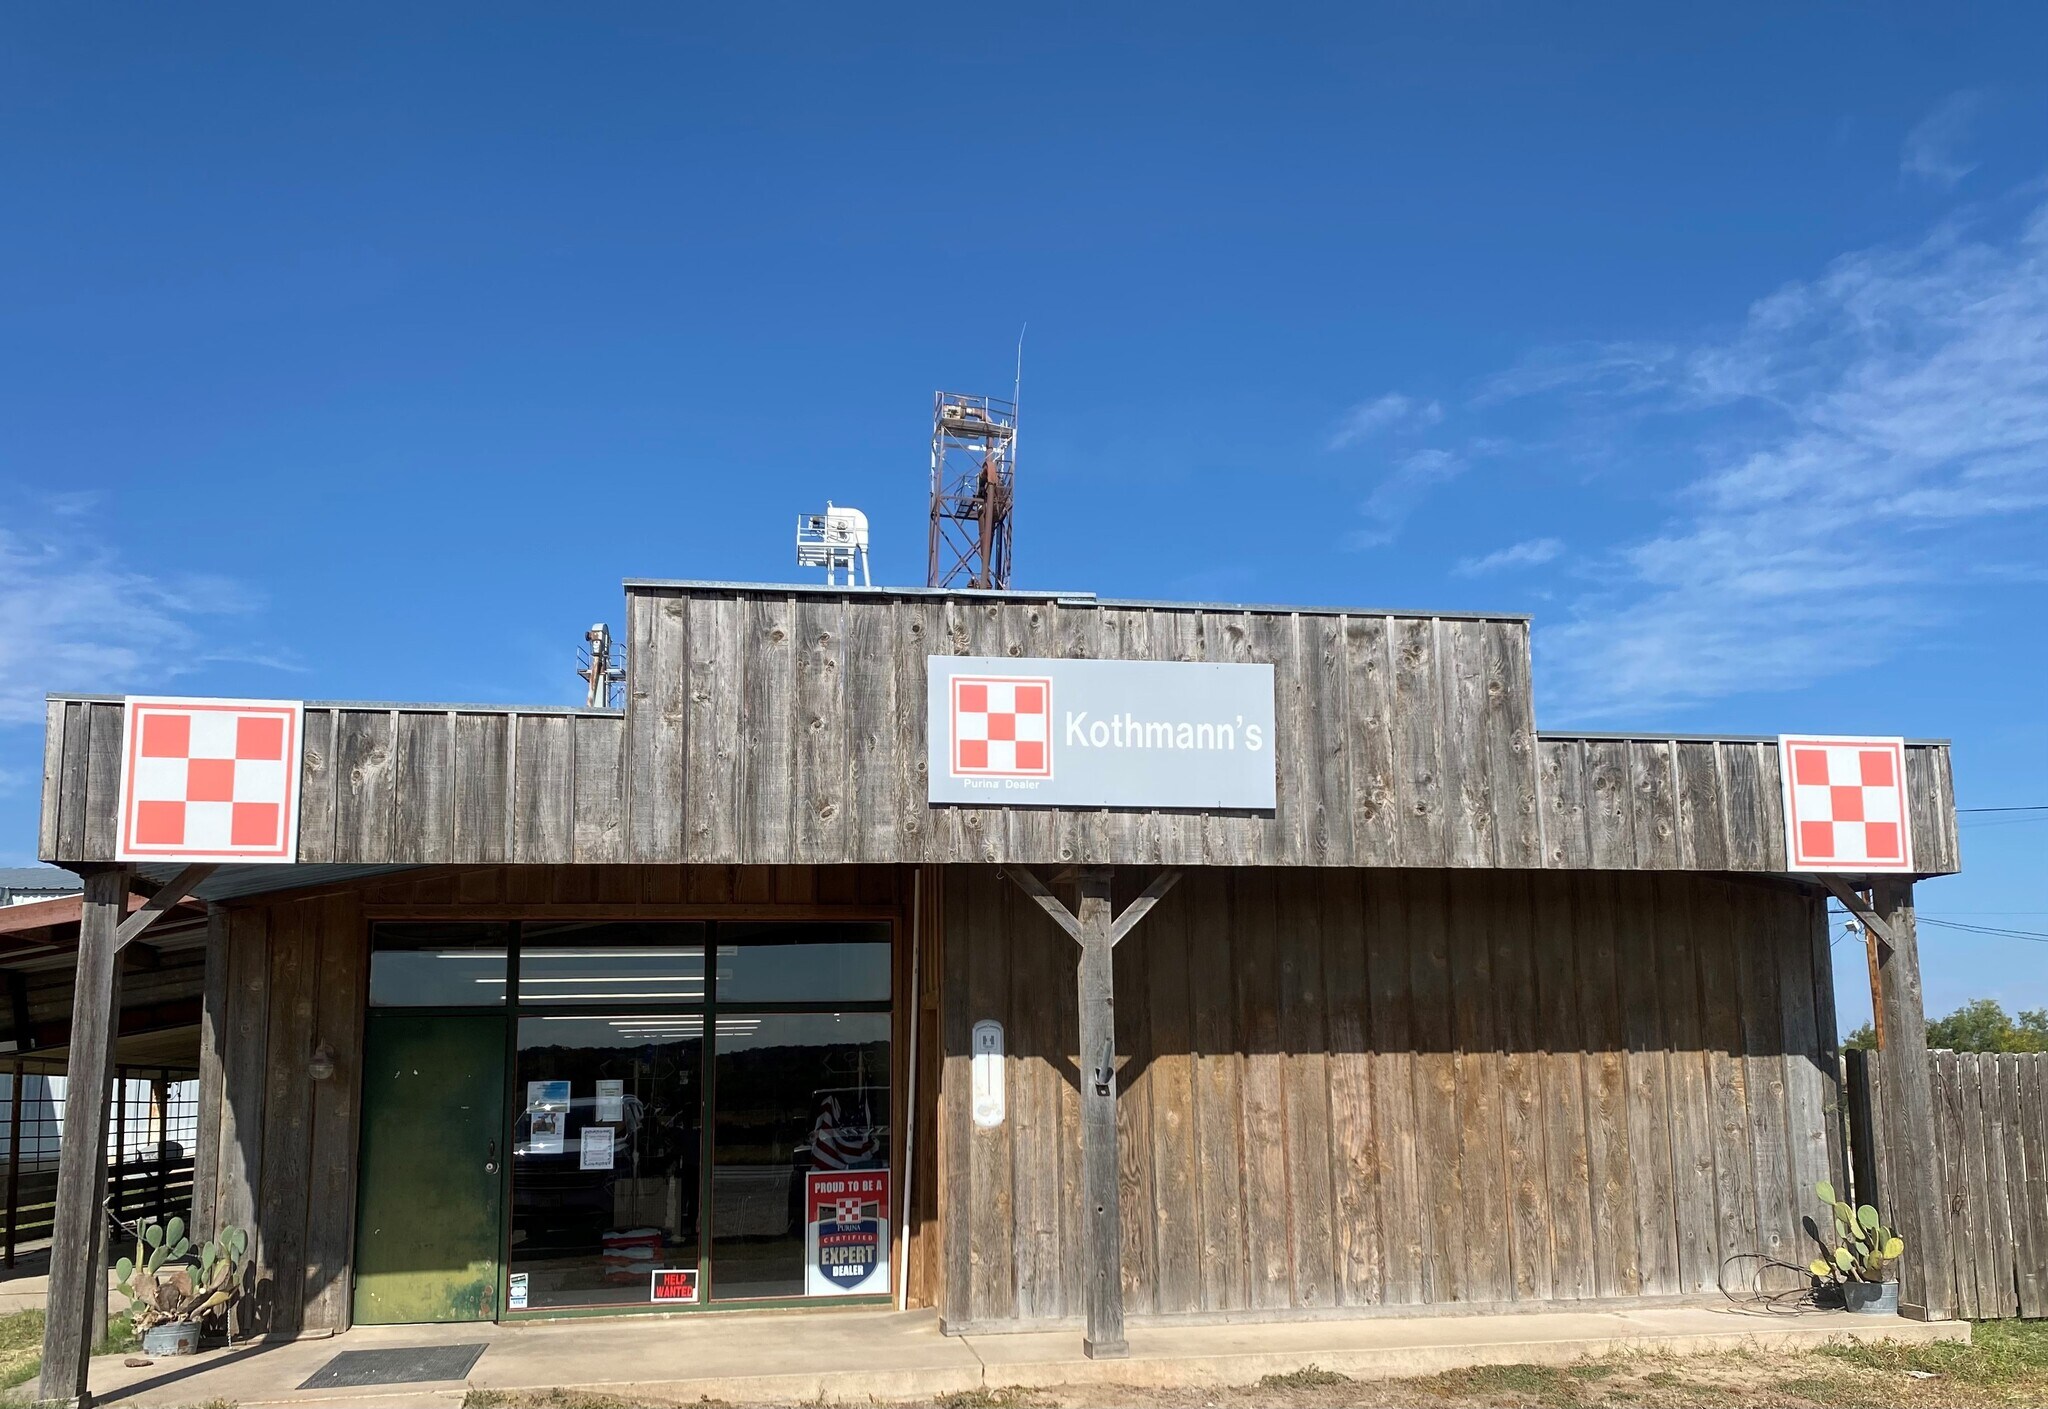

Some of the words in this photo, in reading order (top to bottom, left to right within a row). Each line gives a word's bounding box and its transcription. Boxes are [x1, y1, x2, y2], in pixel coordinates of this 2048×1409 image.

[1065, 711, 1263, 751] Kothmann's
[963, 778, 999, 789] Purina
[1005, 780, 1040, 789] Dealer
[814, 1182, 845, 1194] PROUD
[847, 1181, 859, 1192] TO
[862, 1180, 874, 1191] BE
[876, 1180, 882, 1191] A
[823, 1235, 873, 1243] CERTIFIED
[821, 1245, 874, 1265] EXPERT
[832, 1265, 864, 1277] DEALER
[664, 1273, 687, 1286] HELP
[656, 1285, 693, 1298] WANTED
